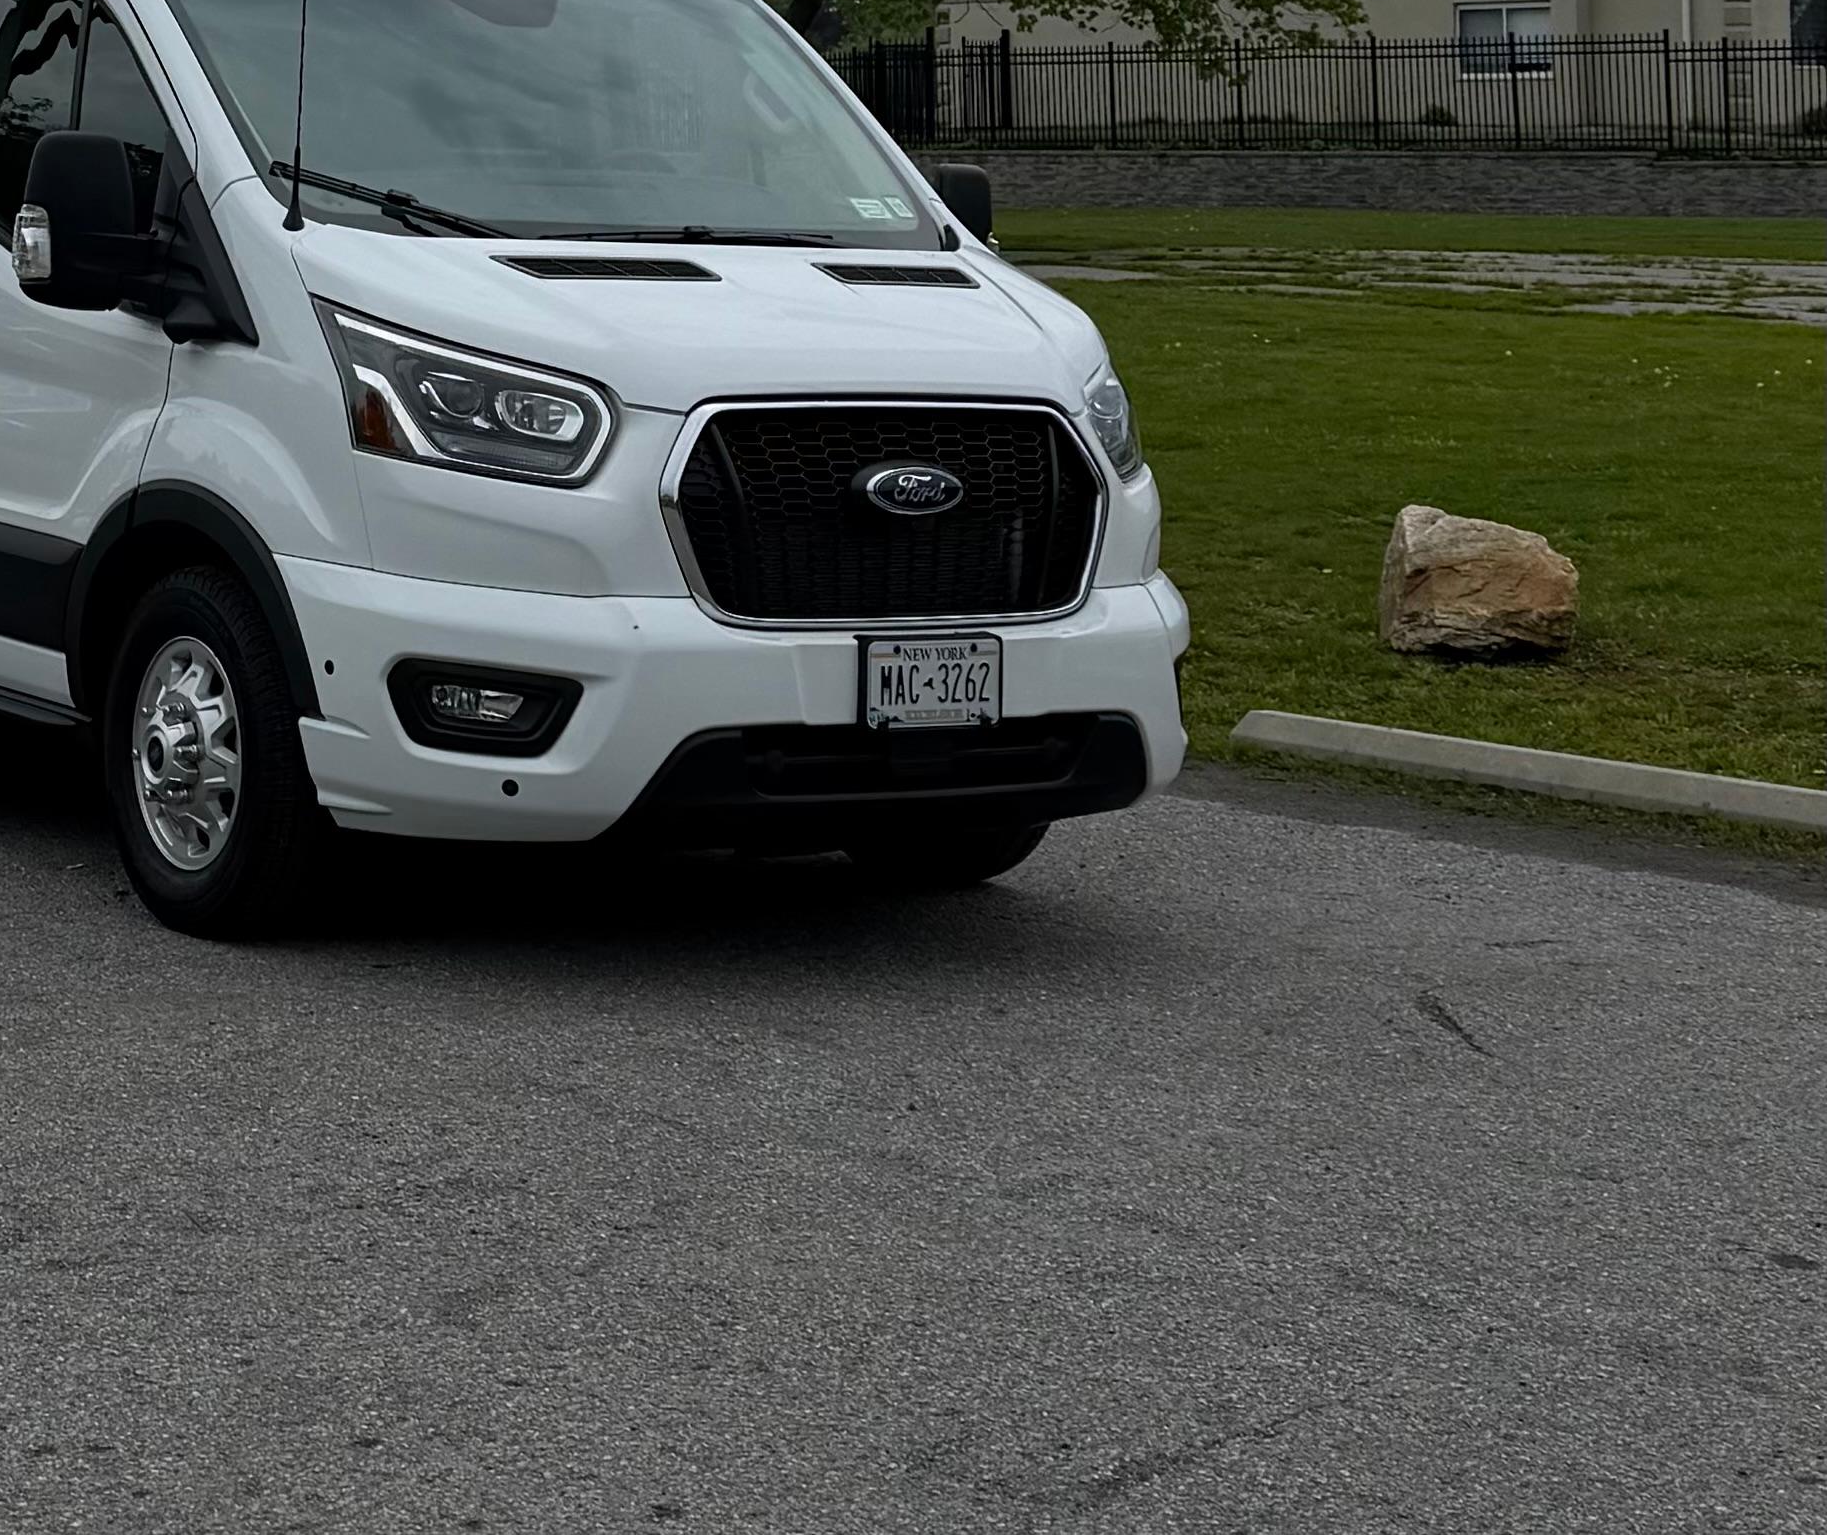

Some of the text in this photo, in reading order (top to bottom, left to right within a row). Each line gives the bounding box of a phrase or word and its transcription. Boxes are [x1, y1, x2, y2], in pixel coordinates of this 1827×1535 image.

[894, 474, 946, 502] Ford
[903, 646, 968, 661] NEW YORK
[937, 662, 990, 703] 3262
